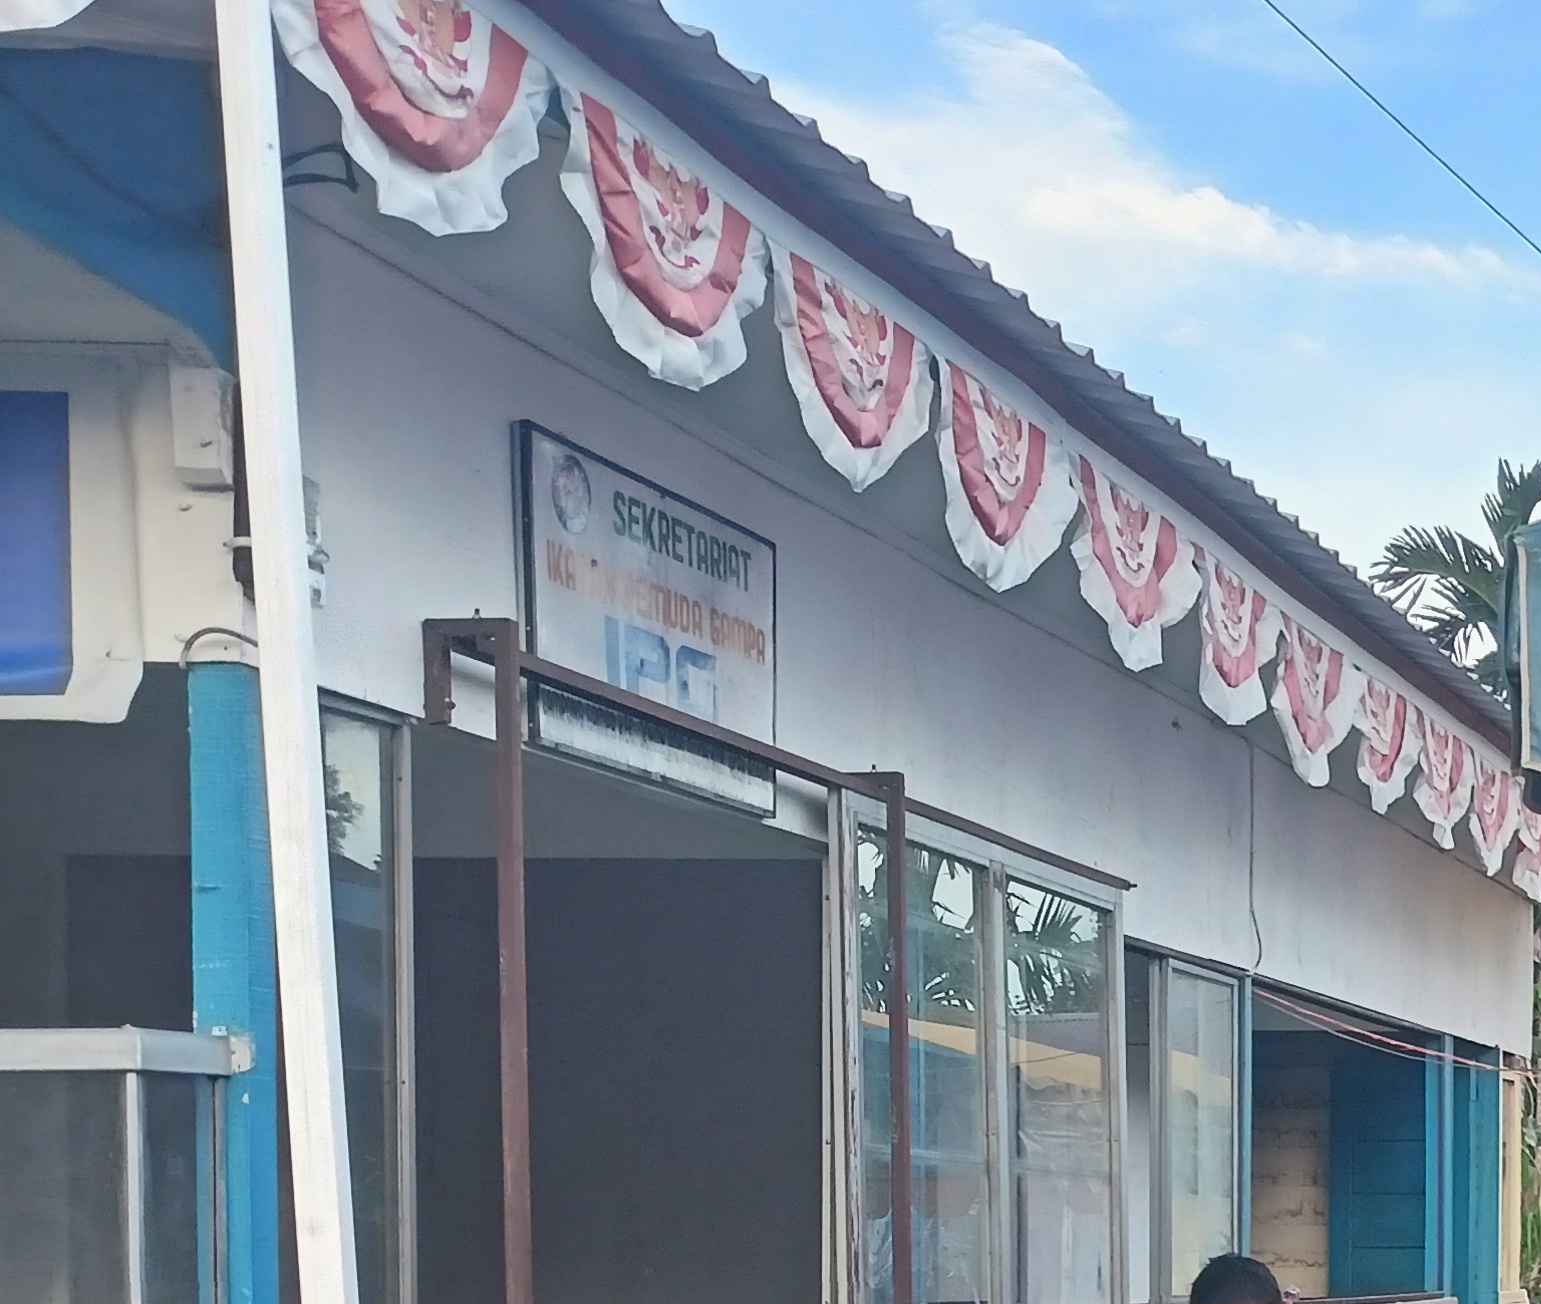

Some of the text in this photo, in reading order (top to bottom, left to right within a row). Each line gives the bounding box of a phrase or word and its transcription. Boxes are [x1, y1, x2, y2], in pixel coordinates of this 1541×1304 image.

[613, 490, 751, 592] SEKRETARIAT
[546, 539, 617, 601] IKA
[710, 607, 766, 664] GAMPA
